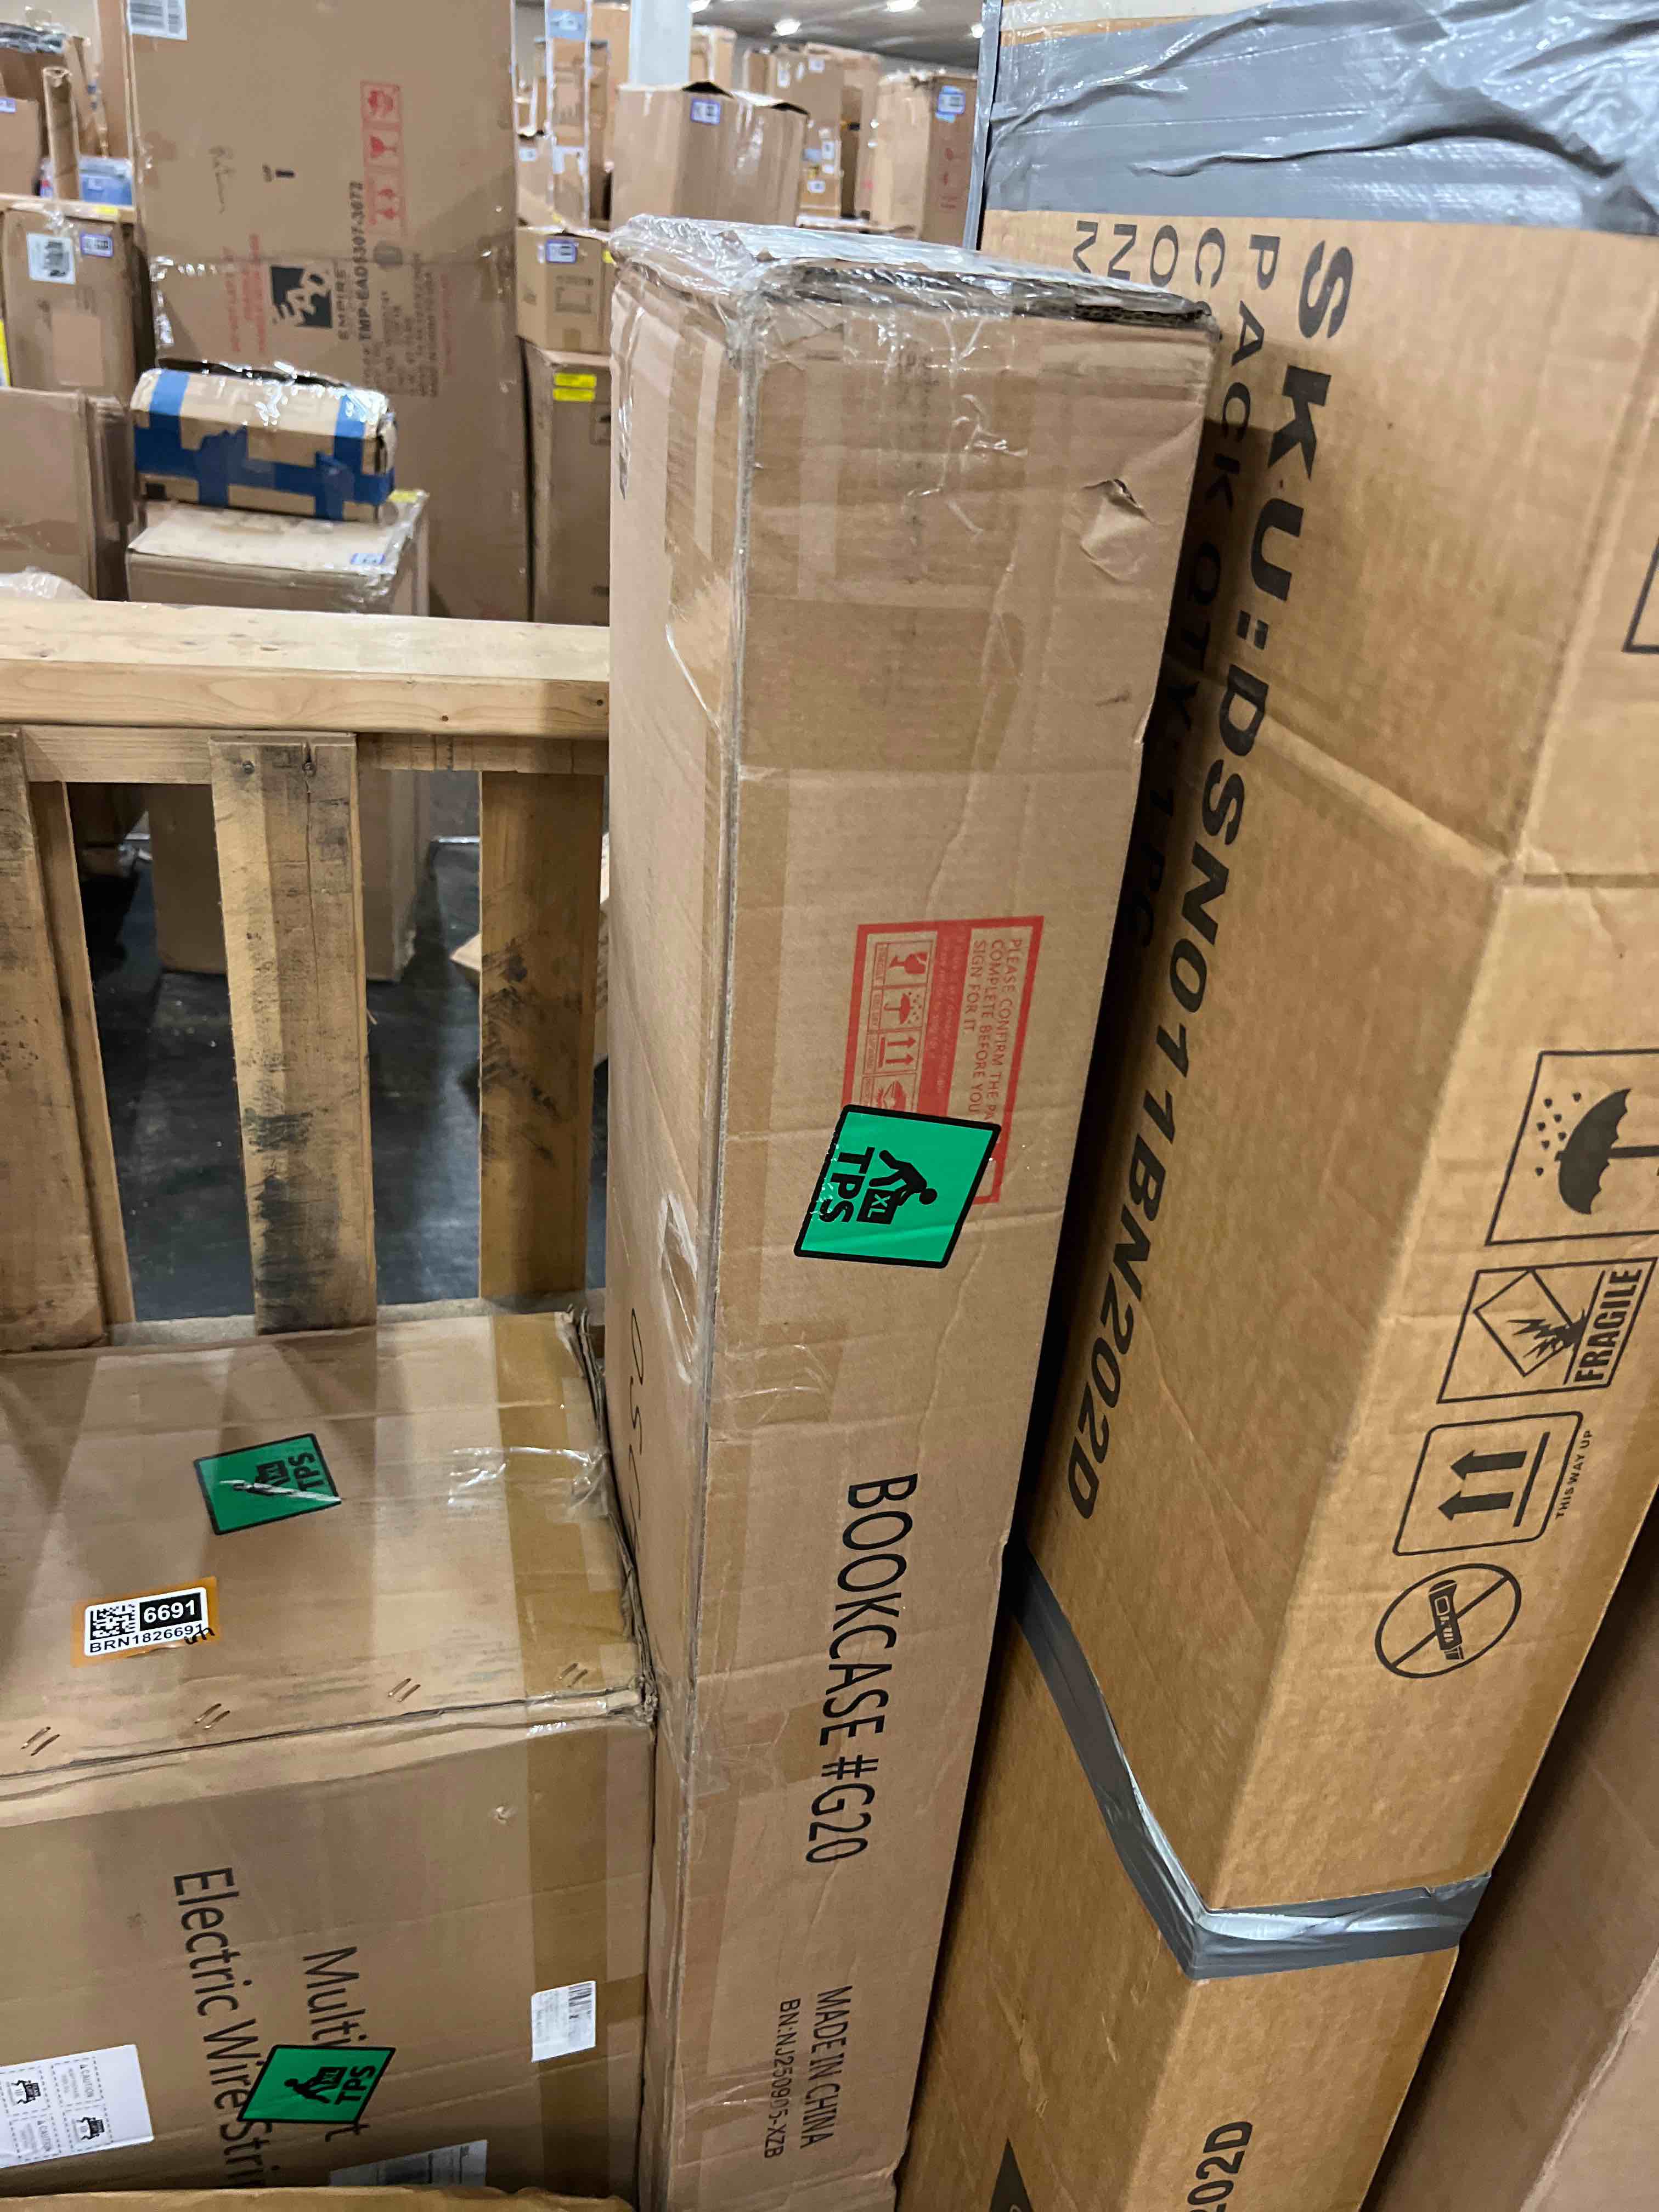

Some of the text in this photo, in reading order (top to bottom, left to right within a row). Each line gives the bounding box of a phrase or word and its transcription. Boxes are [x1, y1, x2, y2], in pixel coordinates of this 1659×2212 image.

[1208, 234, 1281, 511] PACK
[969, 939, 986, 984] SIGN
[1004, 939, 1023, 993] PLEASE
[965, 985, 982, 1014] FOR
[968, 939, 1005, 1115] COMPLETE BEFORE YOU
[996, 996, 1013, 1066] CONFIRM
[991, 1071, 1003, 1097] THE
[818, 1146, 876, 1223] TPS
[867, 1193, 891, 1218] XL
[1574, 1268, 1643, 1383] FRAGILE
[287, 1452, 325, 1491] TPS
[1555, 1430, 1593, 1519] THIS WAY UP
[90, 1622, 205, 1653] BRN1826691
[143, 1599, 196, 1623] 6691
[805, 1472, 919, 1864] BOOKCASE #G20
[173, 1867, 252, 2017] Electric
[203, 2017, 267, 2111] Wire
[334, 2065, 376, 2105] TPS
[799, 1985, 853, 2149] MADE IN CHINA
